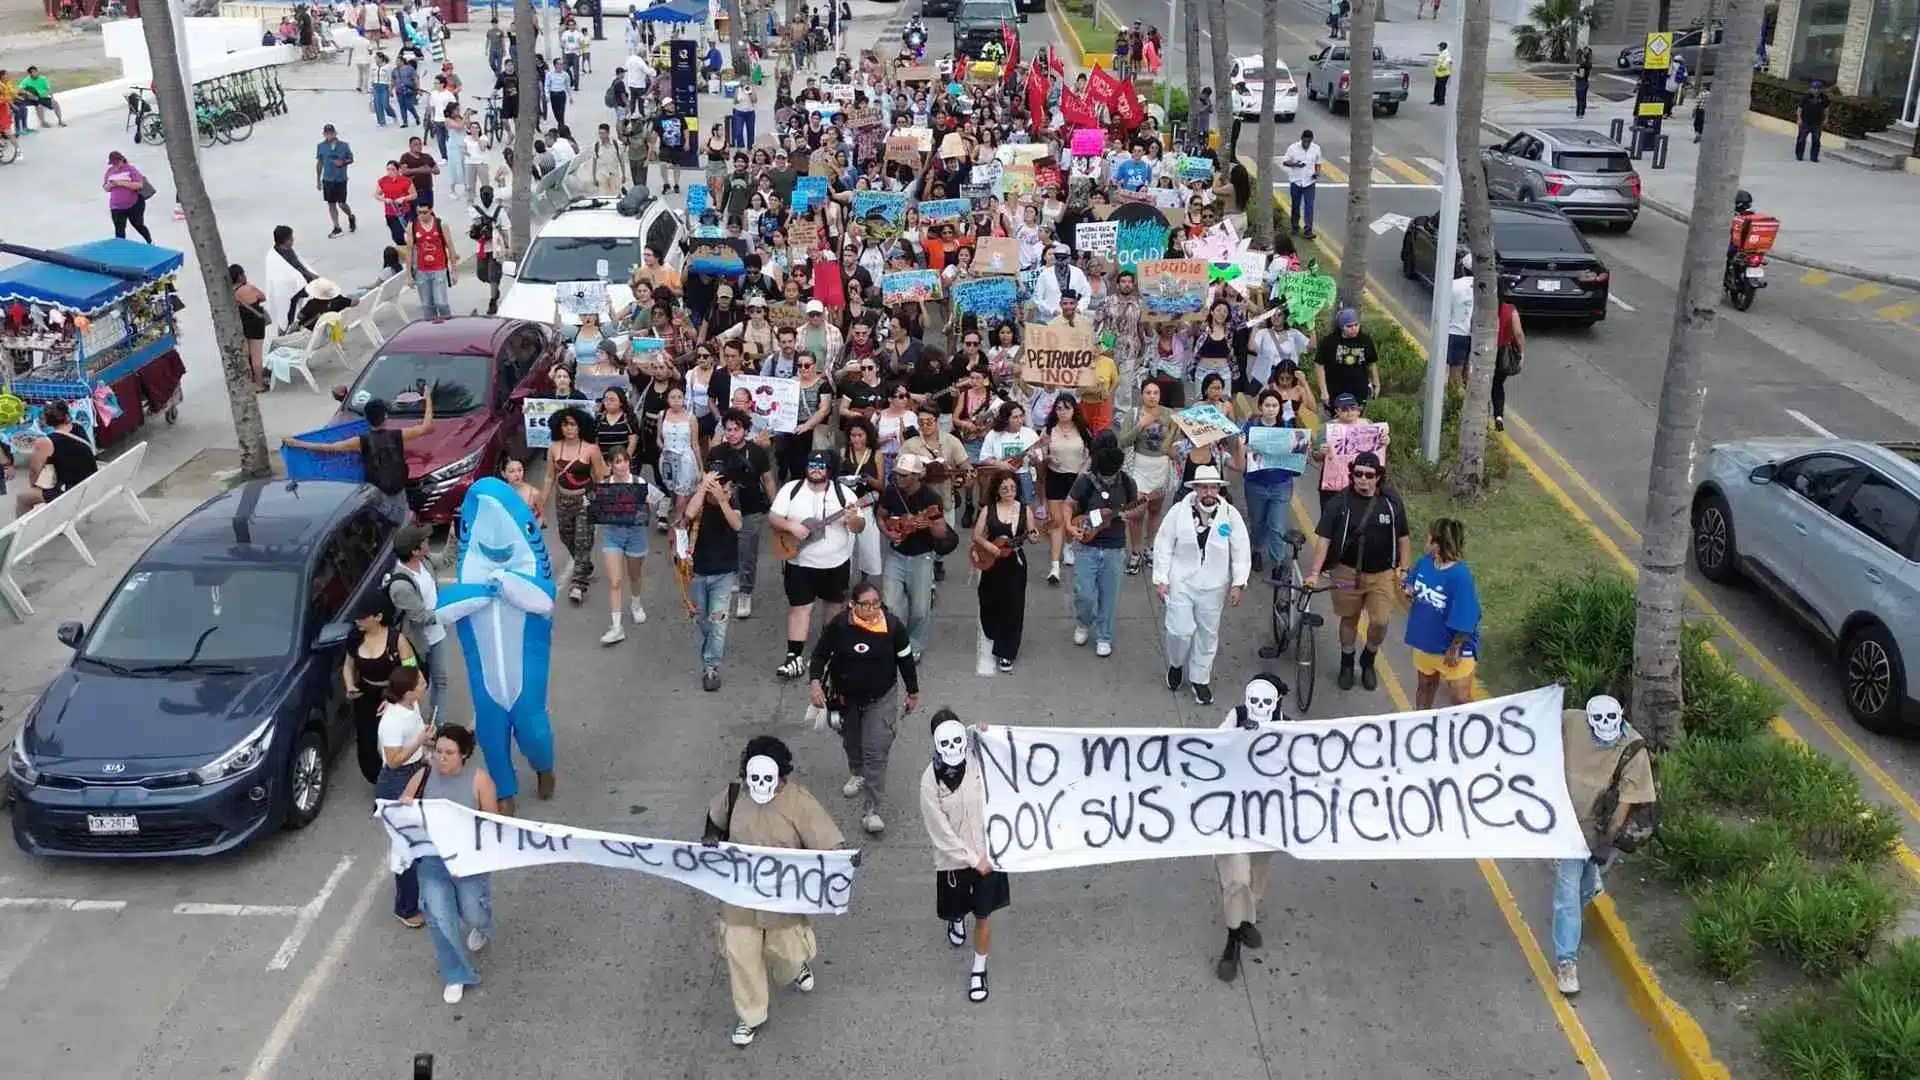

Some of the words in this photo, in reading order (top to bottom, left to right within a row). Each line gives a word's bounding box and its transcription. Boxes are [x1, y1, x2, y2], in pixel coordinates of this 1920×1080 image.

[1144, 260, 1201, 277] ECOCIDIO
[1027, 348, 1092, 369] PETROLEO
[972, 728, 1060, 804] No
[1082, 735, 1226, 782] mas
[987, 790, 1065, 869] por
[1081, 786, 1175, 848] sus
[672, 845, 852, 909] defiende
